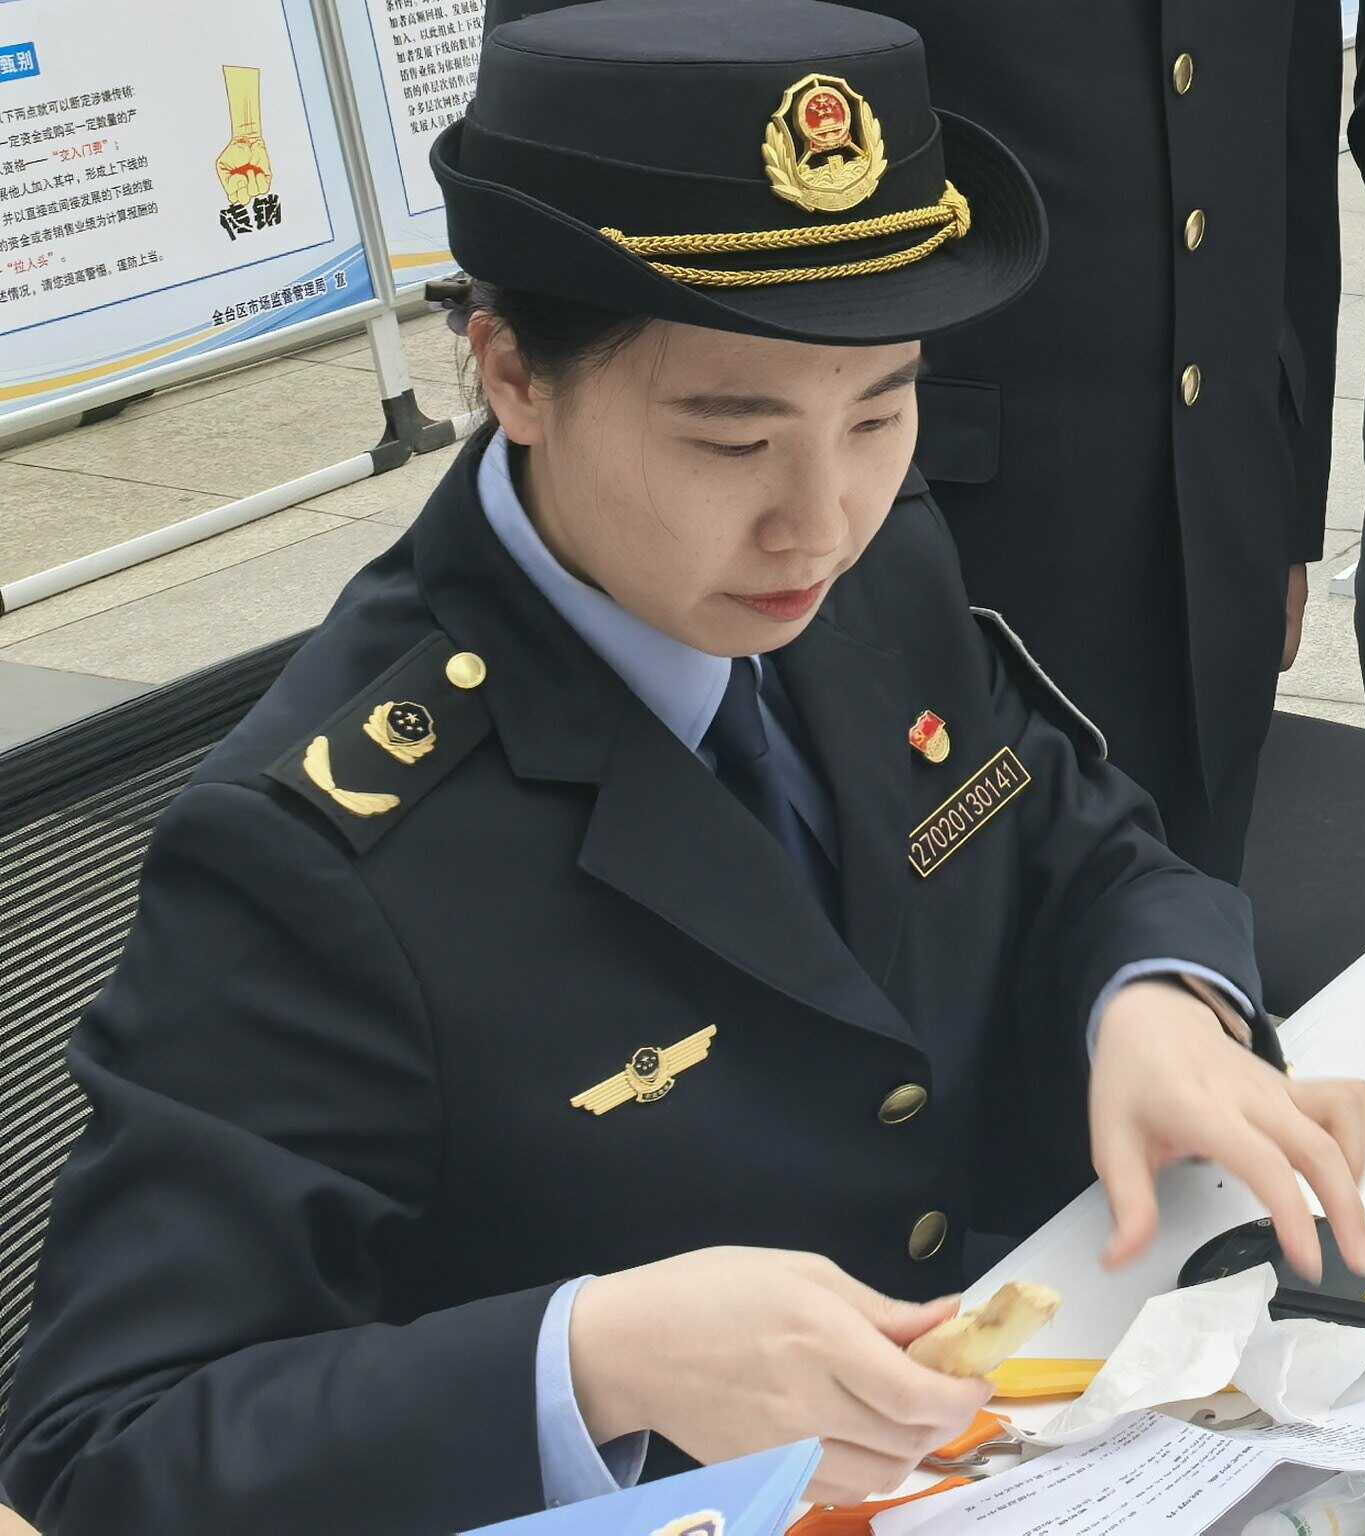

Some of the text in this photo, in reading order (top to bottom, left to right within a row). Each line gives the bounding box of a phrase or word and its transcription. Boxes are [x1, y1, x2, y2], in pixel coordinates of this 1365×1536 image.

[219, 194, 283, 241] 传销
[212, 277, 327, 327] 金台区市场监督管理局
[911, 760, 1019, 867] 27020130141
